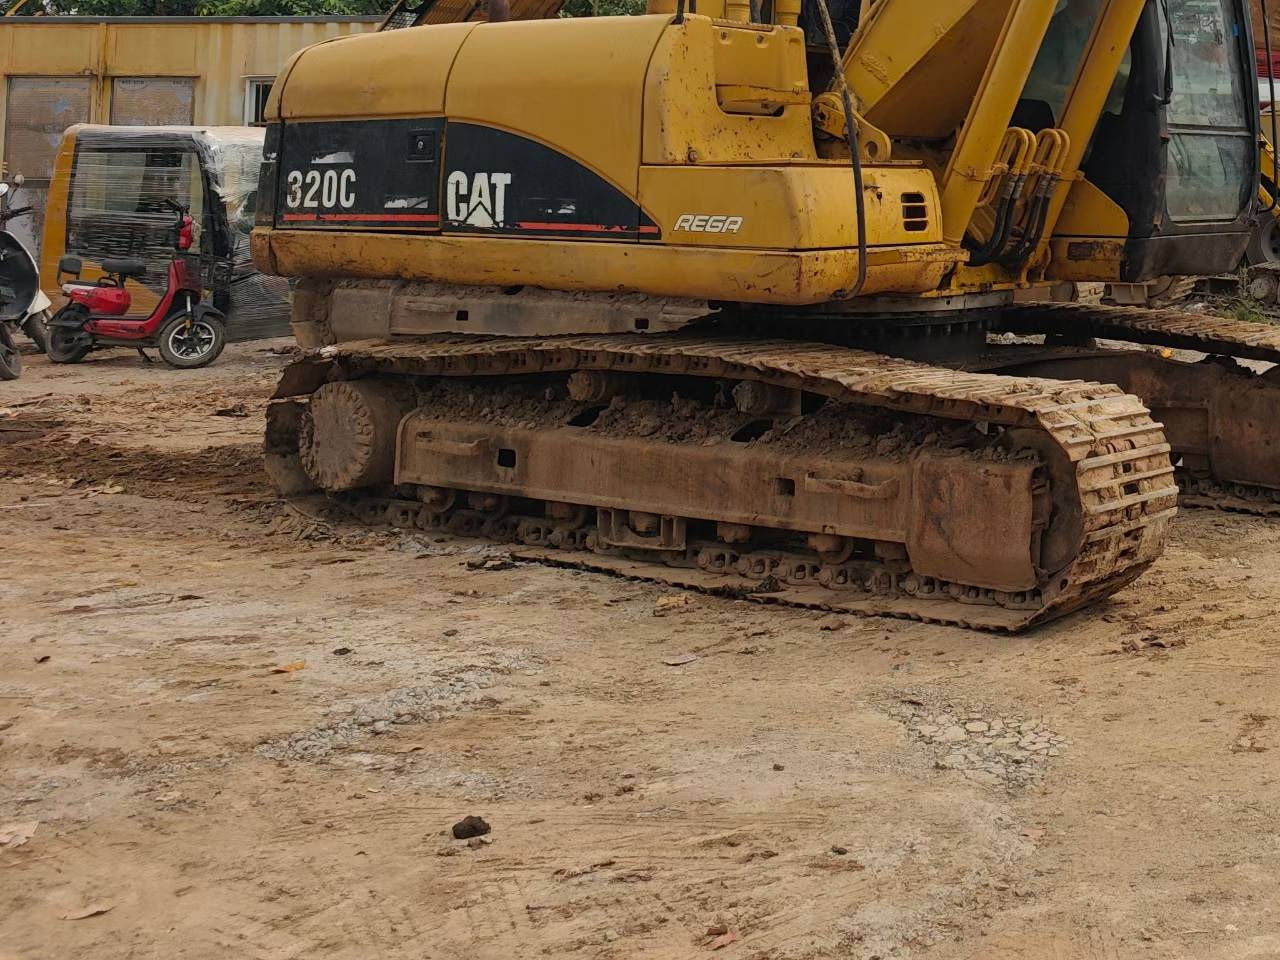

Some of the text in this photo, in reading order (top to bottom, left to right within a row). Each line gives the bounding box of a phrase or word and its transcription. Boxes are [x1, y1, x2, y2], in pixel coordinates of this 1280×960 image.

[286, 168, 357, 209] 320C
[446, 170, 512, 228] CAT
[672, 213, 744, 234] REGA
